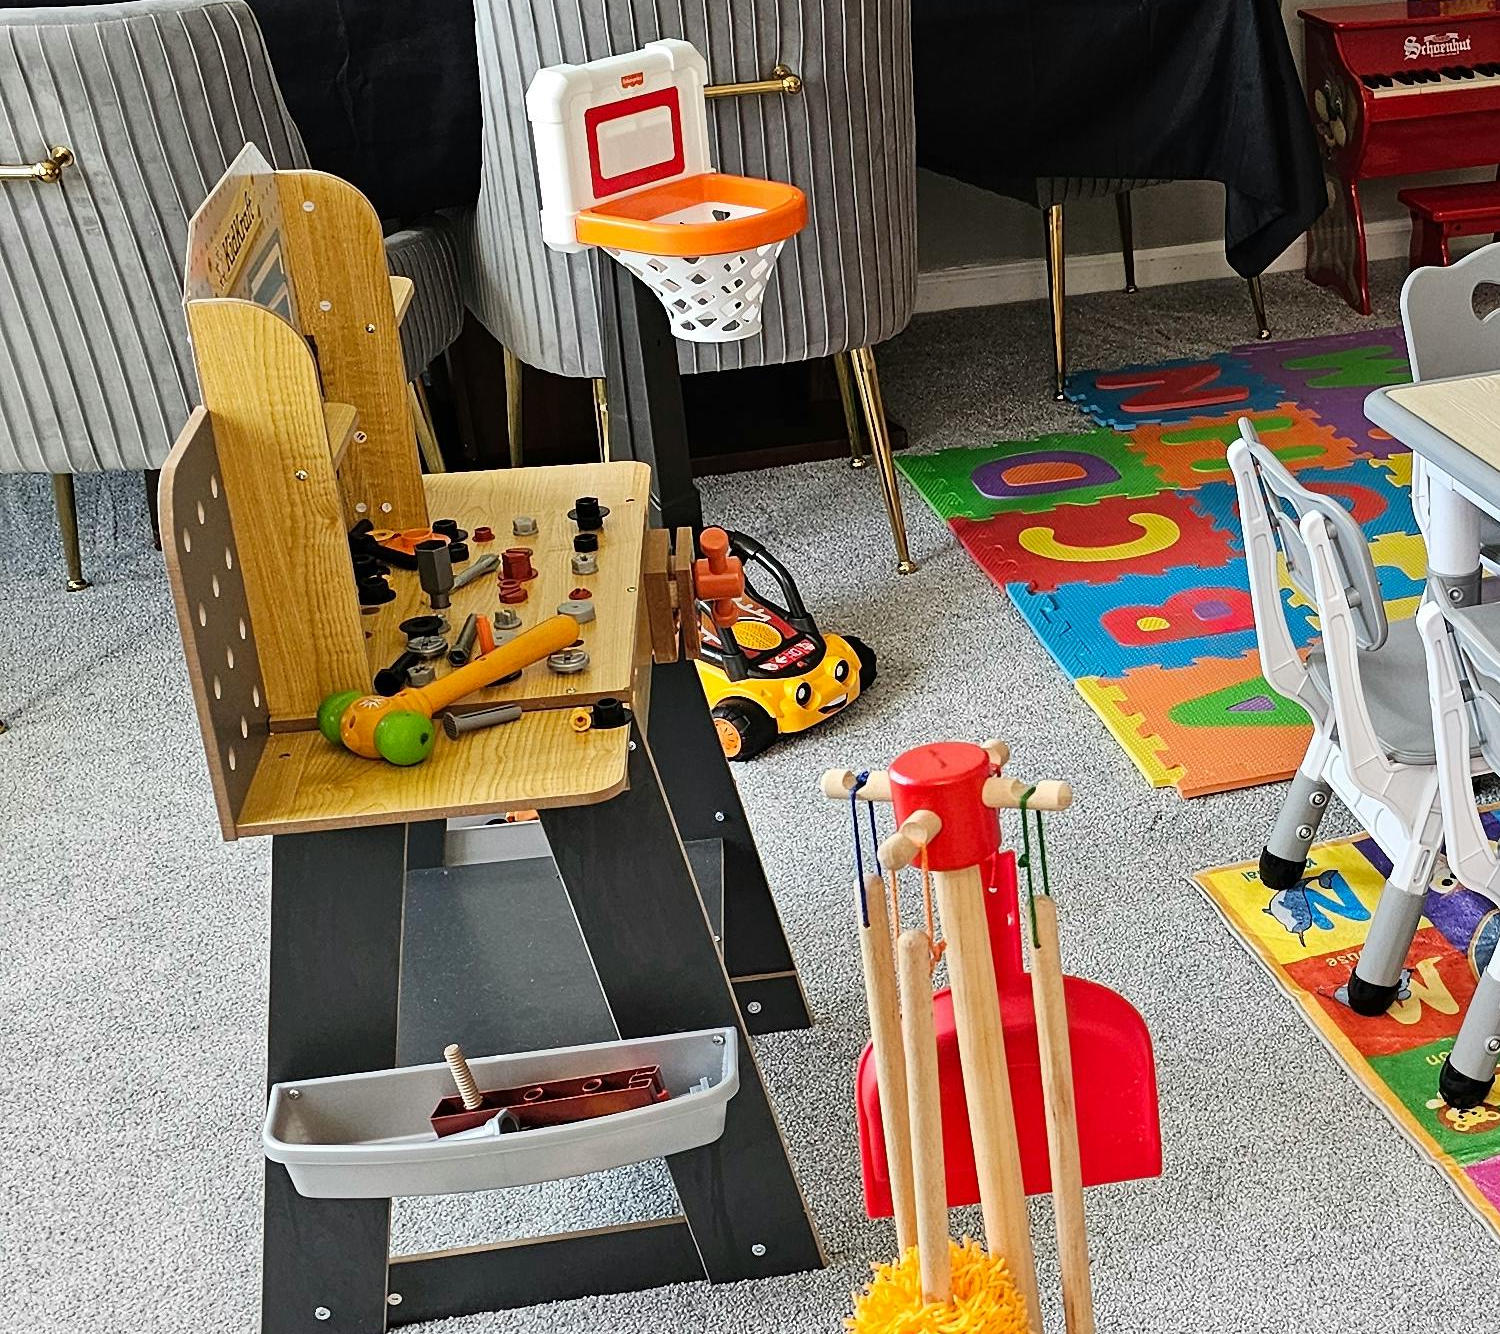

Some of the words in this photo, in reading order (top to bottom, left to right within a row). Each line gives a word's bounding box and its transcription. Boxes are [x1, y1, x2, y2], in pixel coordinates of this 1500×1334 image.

[1404, 36, 1471, 60] Schoenhut
[221, 190, 256, 272] KidKraft
[970, 450, 1122, 499] D
[1018, 512, 1181, 563] C
[1100, 586, 1255, 648] B
